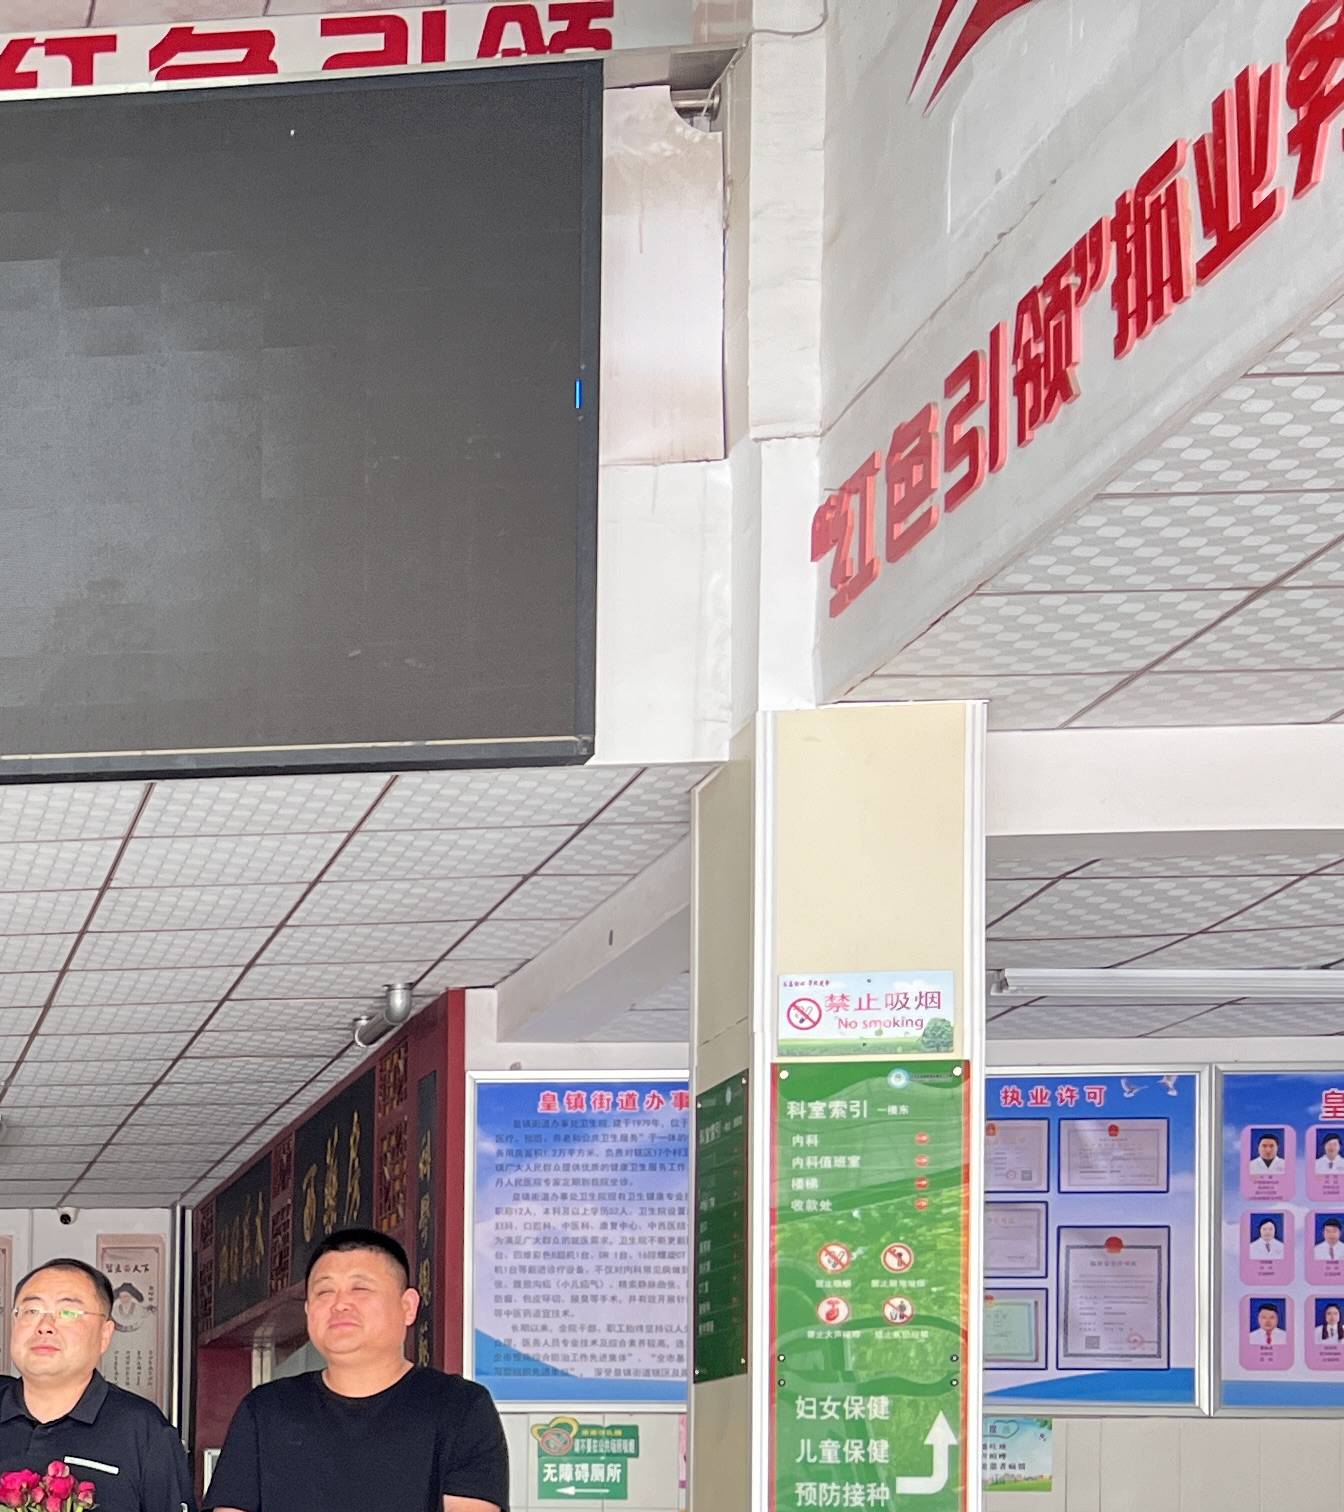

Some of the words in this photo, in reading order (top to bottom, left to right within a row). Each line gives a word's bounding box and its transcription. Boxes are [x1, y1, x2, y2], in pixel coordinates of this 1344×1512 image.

[824, 991, 941, 1012] 禁止吸烟
[838, 1018, 858, 1030] No
[863, 1017, 924, 1031] smoking
[1001, 1086, 1106, 1106] 执业许可
[787, 1100, 868, 1119] 科室索引
[792, 1134, 819, 1147] 内科
[791, 1177, 818, 1190] 楼梯
[795, 1396, 890, 1420] 妇女保健
[795, 1439, 890, 1464] 儿童保健
[542, 1463, 622, 1483] 无障碍厕所
[795, 1482, 890, 1507] 预防接种
